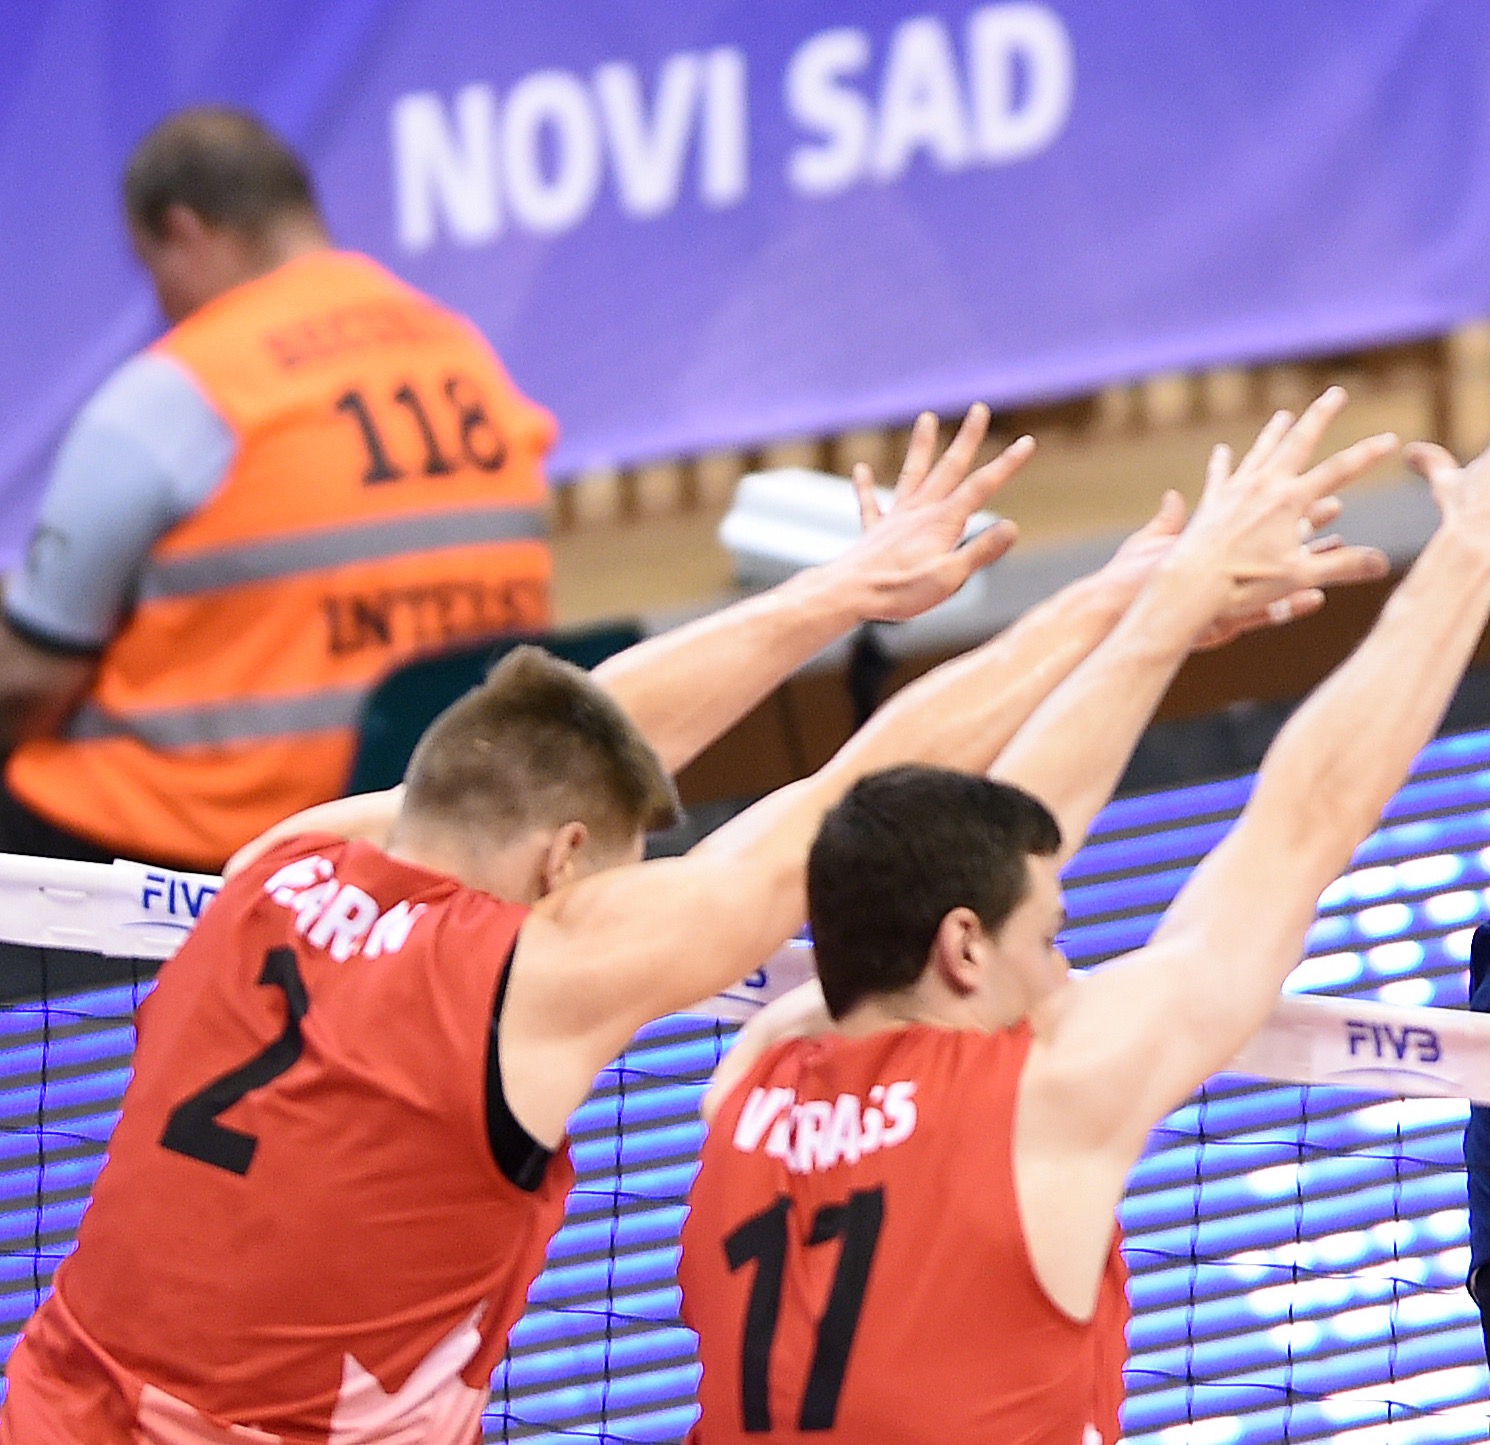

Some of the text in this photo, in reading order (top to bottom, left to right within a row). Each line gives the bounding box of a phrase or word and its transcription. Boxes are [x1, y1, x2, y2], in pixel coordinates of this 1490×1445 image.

[392, 4, 1074, 251] NOVI SAD
[336, 377, 508, 485] 118
[142, 864, 218, 918] FIV
[160, 945, 308, 1175] 2
[1346, 1018, 1441, 1063] FIVB
